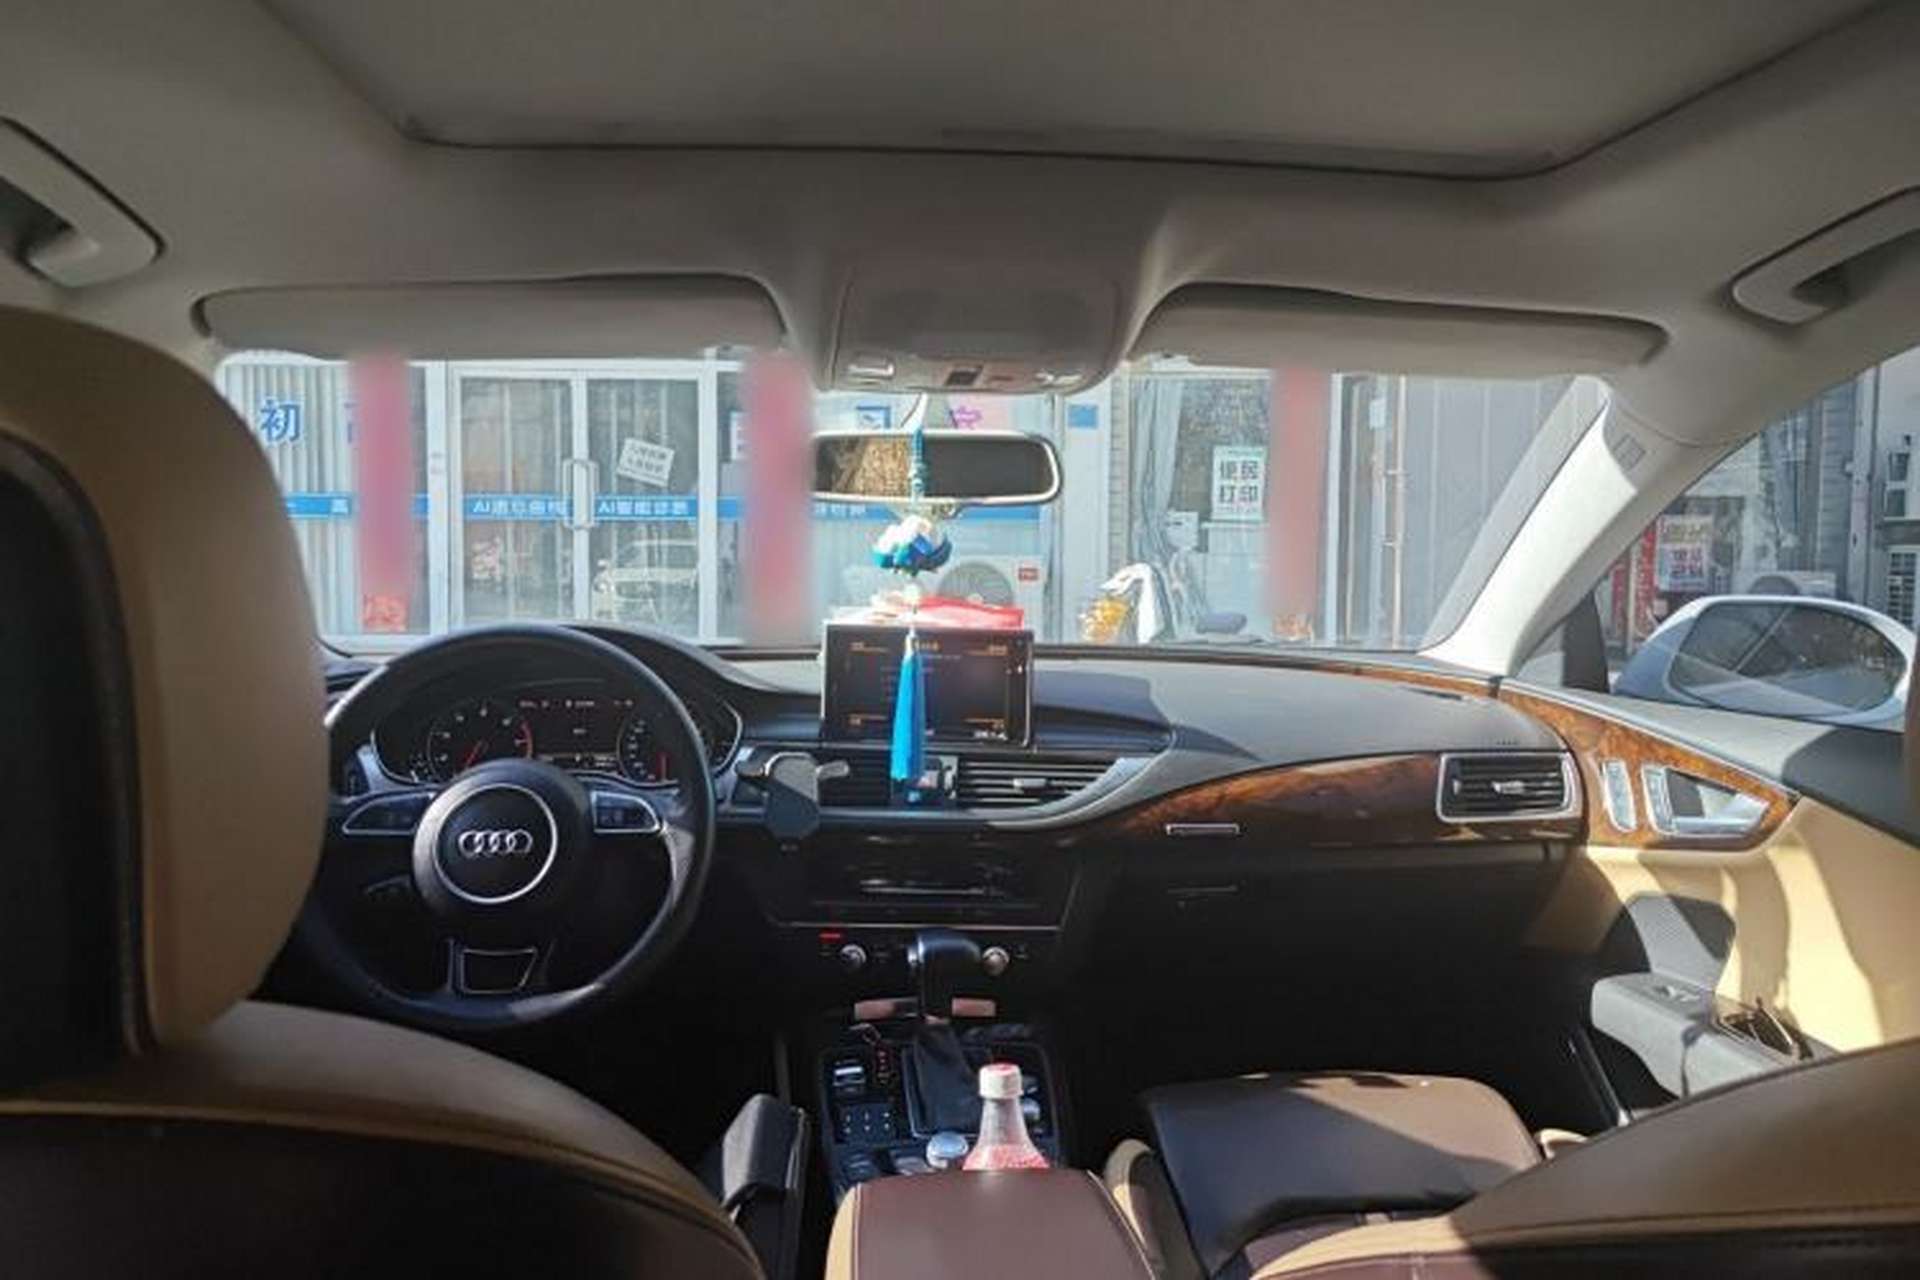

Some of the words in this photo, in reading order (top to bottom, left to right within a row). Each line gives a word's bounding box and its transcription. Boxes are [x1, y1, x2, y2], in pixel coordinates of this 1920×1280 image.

[259, 398, 302, 443] 初
[1220, 460, 1259, 480] 便民
[1219, 485, 1259, 503] 打印
